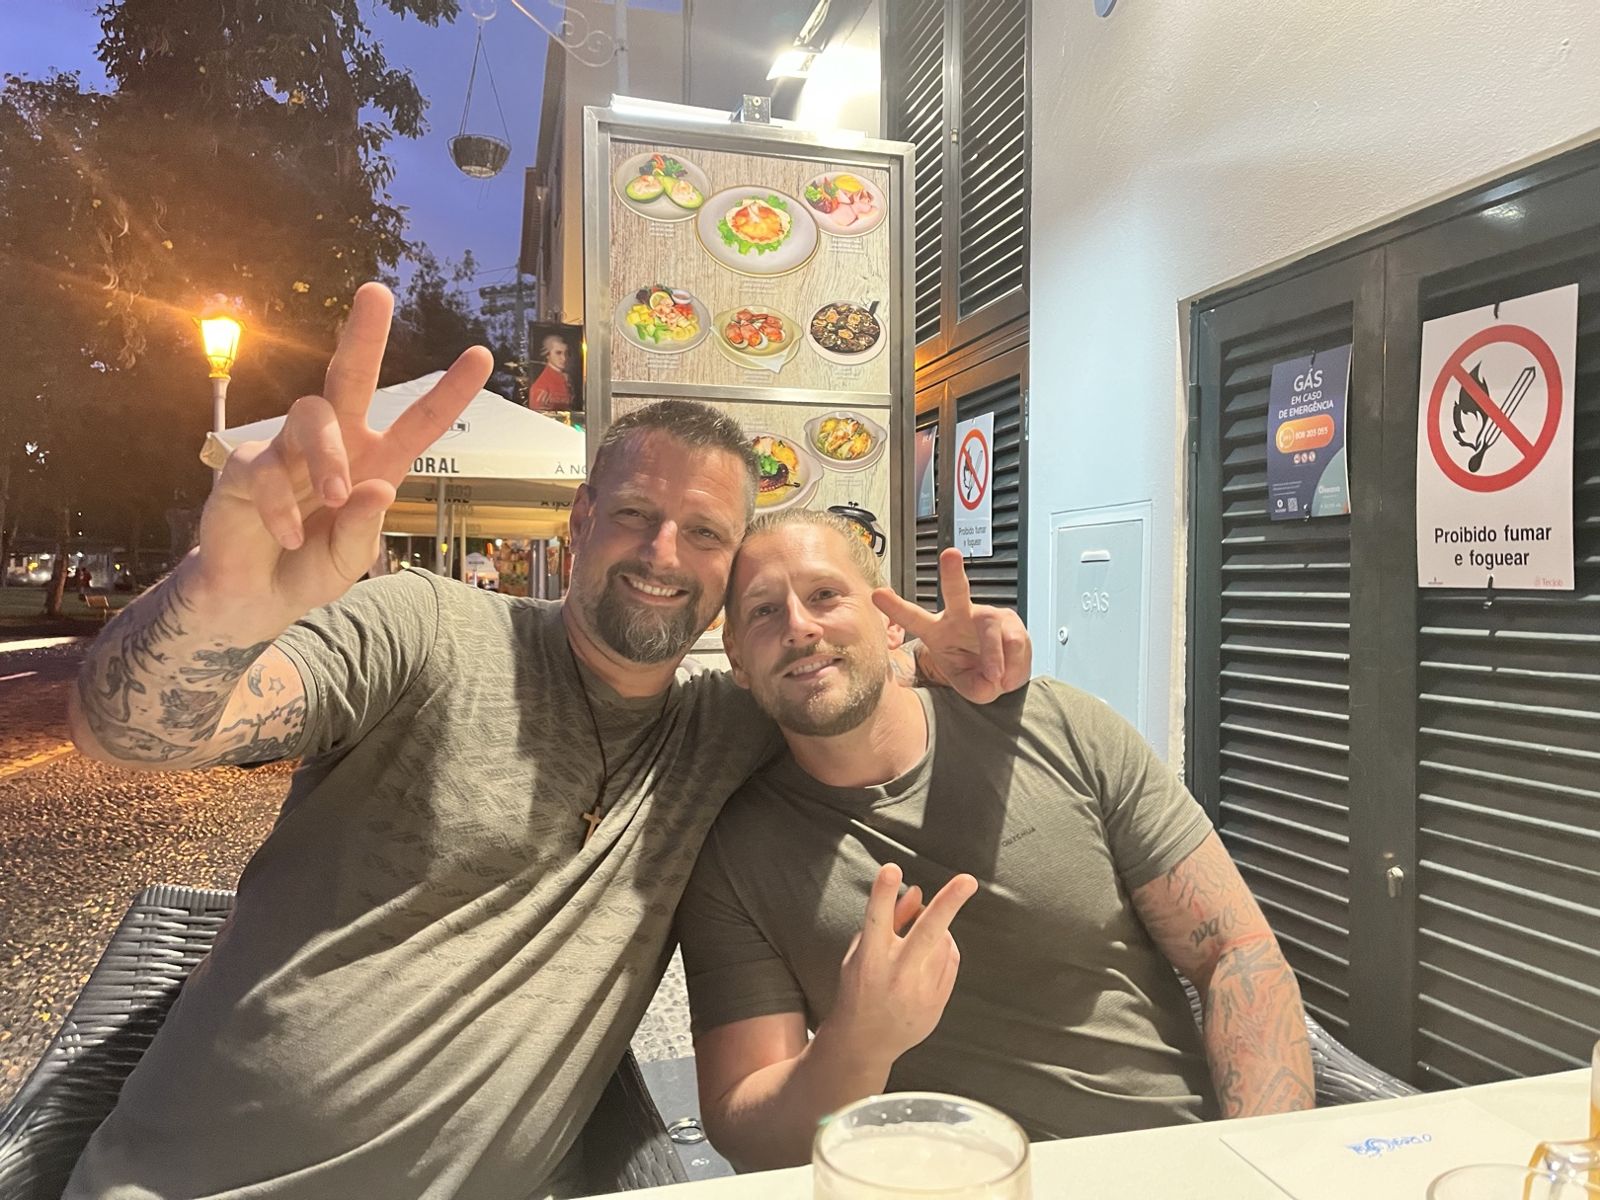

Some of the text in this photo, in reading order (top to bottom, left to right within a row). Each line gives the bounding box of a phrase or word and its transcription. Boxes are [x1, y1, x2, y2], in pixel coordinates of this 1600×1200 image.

[1293, 368, 1323, 392] GÁS
[1291, 390, 1322, 405] EM CASO
[1278, 400, 1334, 419] DE EMERGÊNCIA
[408, 457, 460, 473] ORAL
[1434, 525, 1552, 544] Proibido fumar
[1454, 550, 1530, 570] e foguear
[1081, 587, 1110, 614] GÁS
